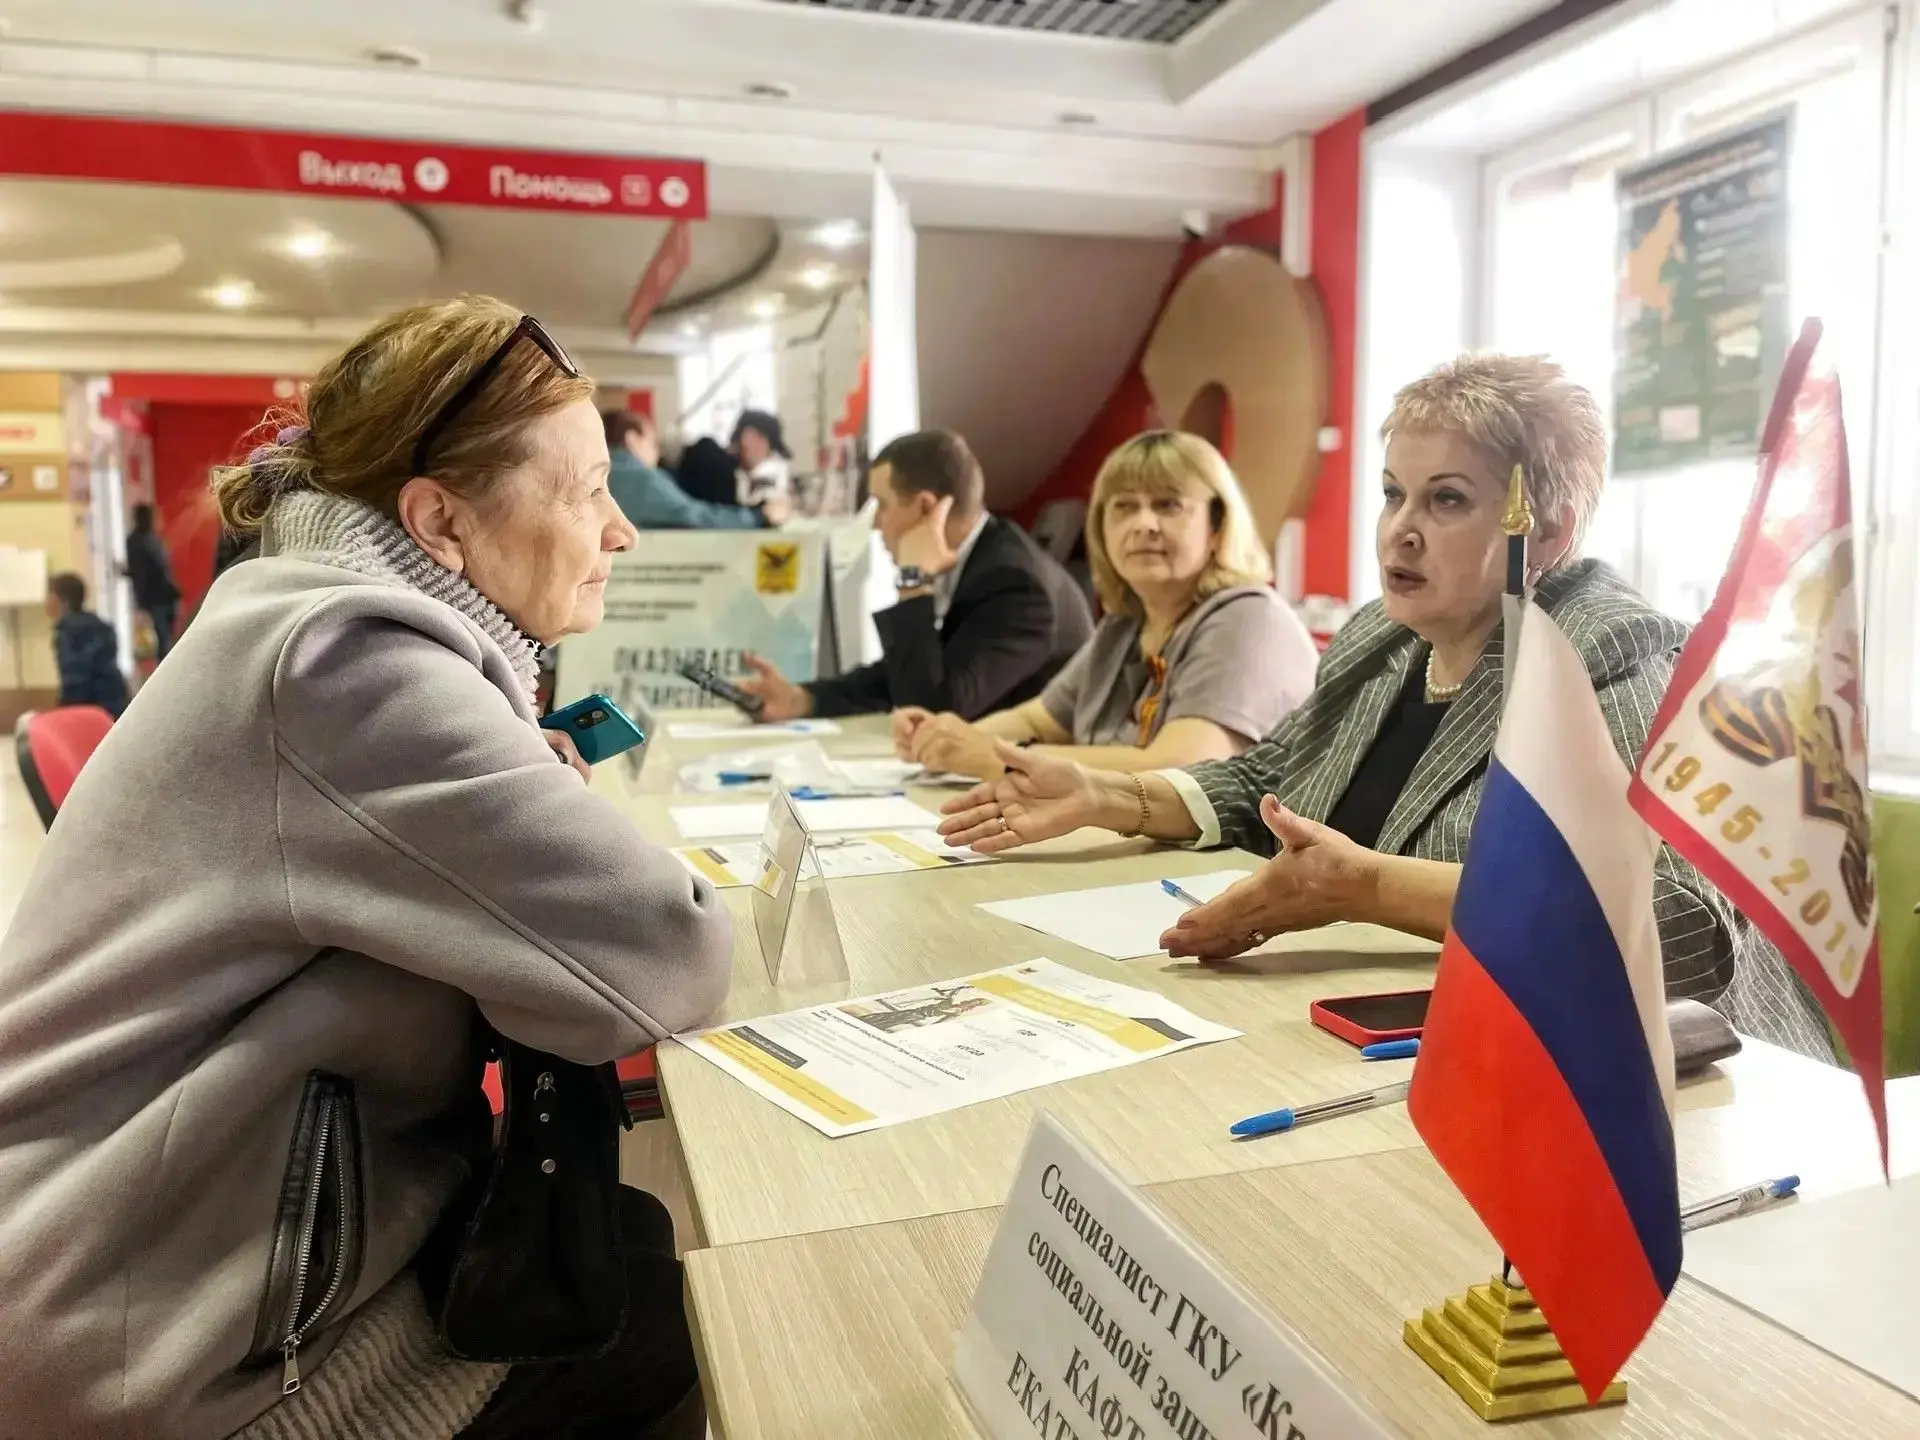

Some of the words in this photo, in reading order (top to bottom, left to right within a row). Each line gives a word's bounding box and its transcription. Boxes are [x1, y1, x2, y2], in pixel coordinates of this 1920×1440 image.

[298, 149, 405, 194] Выход
[489, 165, 613, 206] Помощь
[1041, 1163, 1168, 1316] Специалист
[1166, 1292, 1243, 1382] ГКУ
[1027, 1231, 1153, 1390] социальной
[1150, 1375, 1219, 1440] защ
[1006, 1350, 1080, 1440] ЕКАТ
[1062, 1344, 1147, 1440] КАФТ
